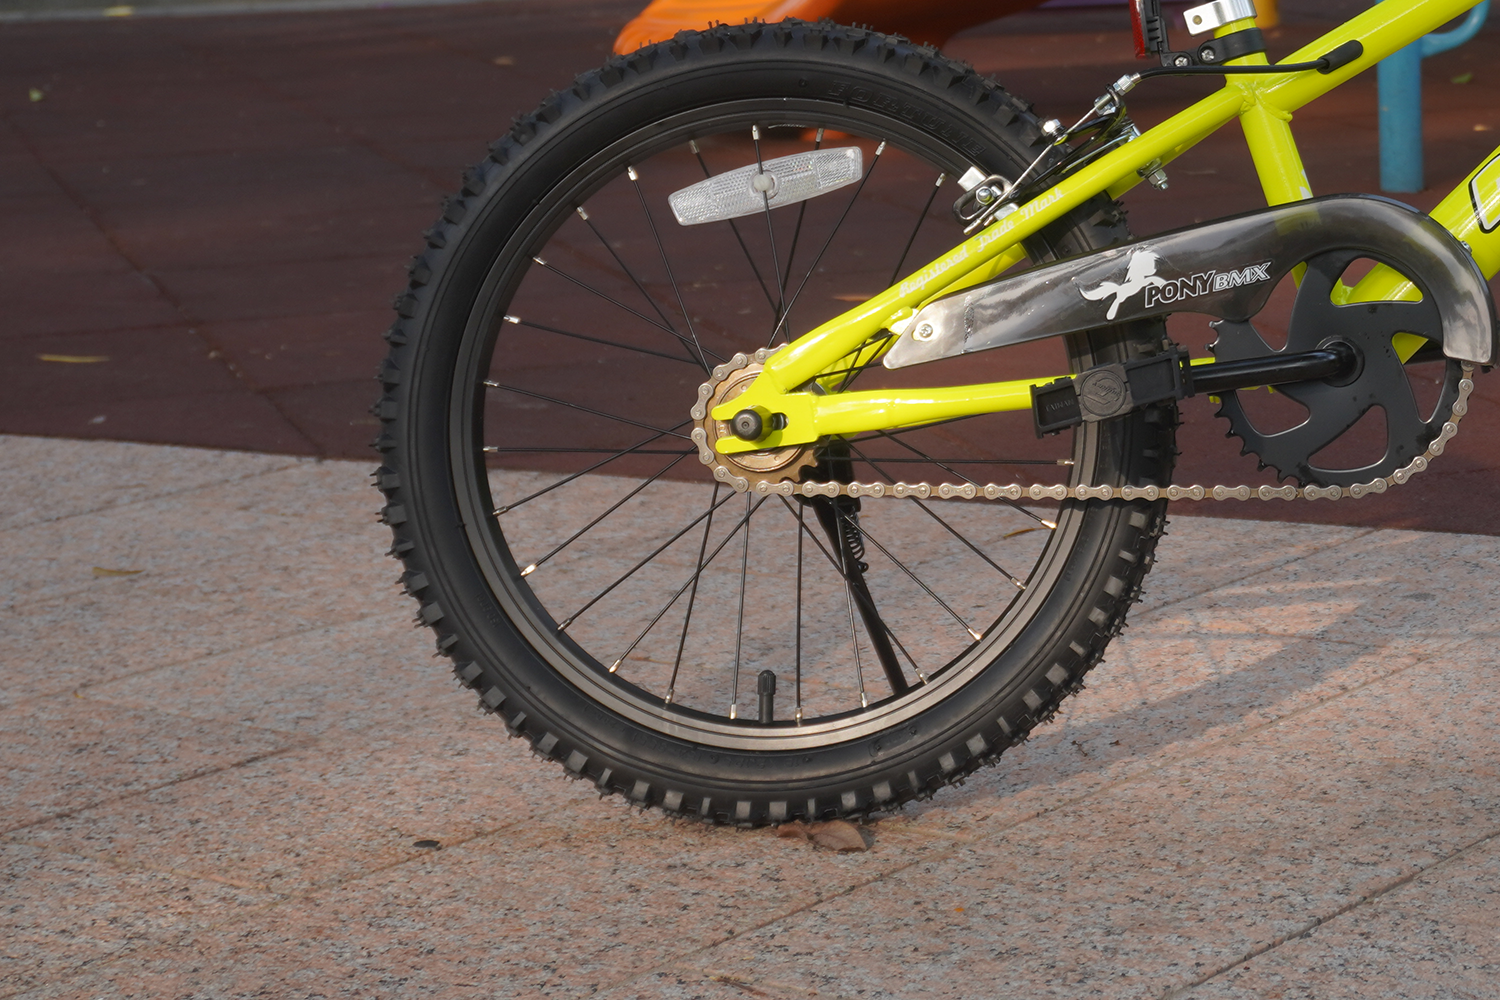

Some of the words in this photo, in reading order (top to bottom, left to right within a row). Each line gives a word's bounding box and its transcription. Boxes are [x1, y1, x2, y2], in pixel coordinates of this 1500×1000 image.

[898, 245, 970, 298] Registered
[974, 219, 1015, 253] Trade
[1020, 187, 1065, 221] Mark
[1144, 261, 1272, 308] PONYBMX
